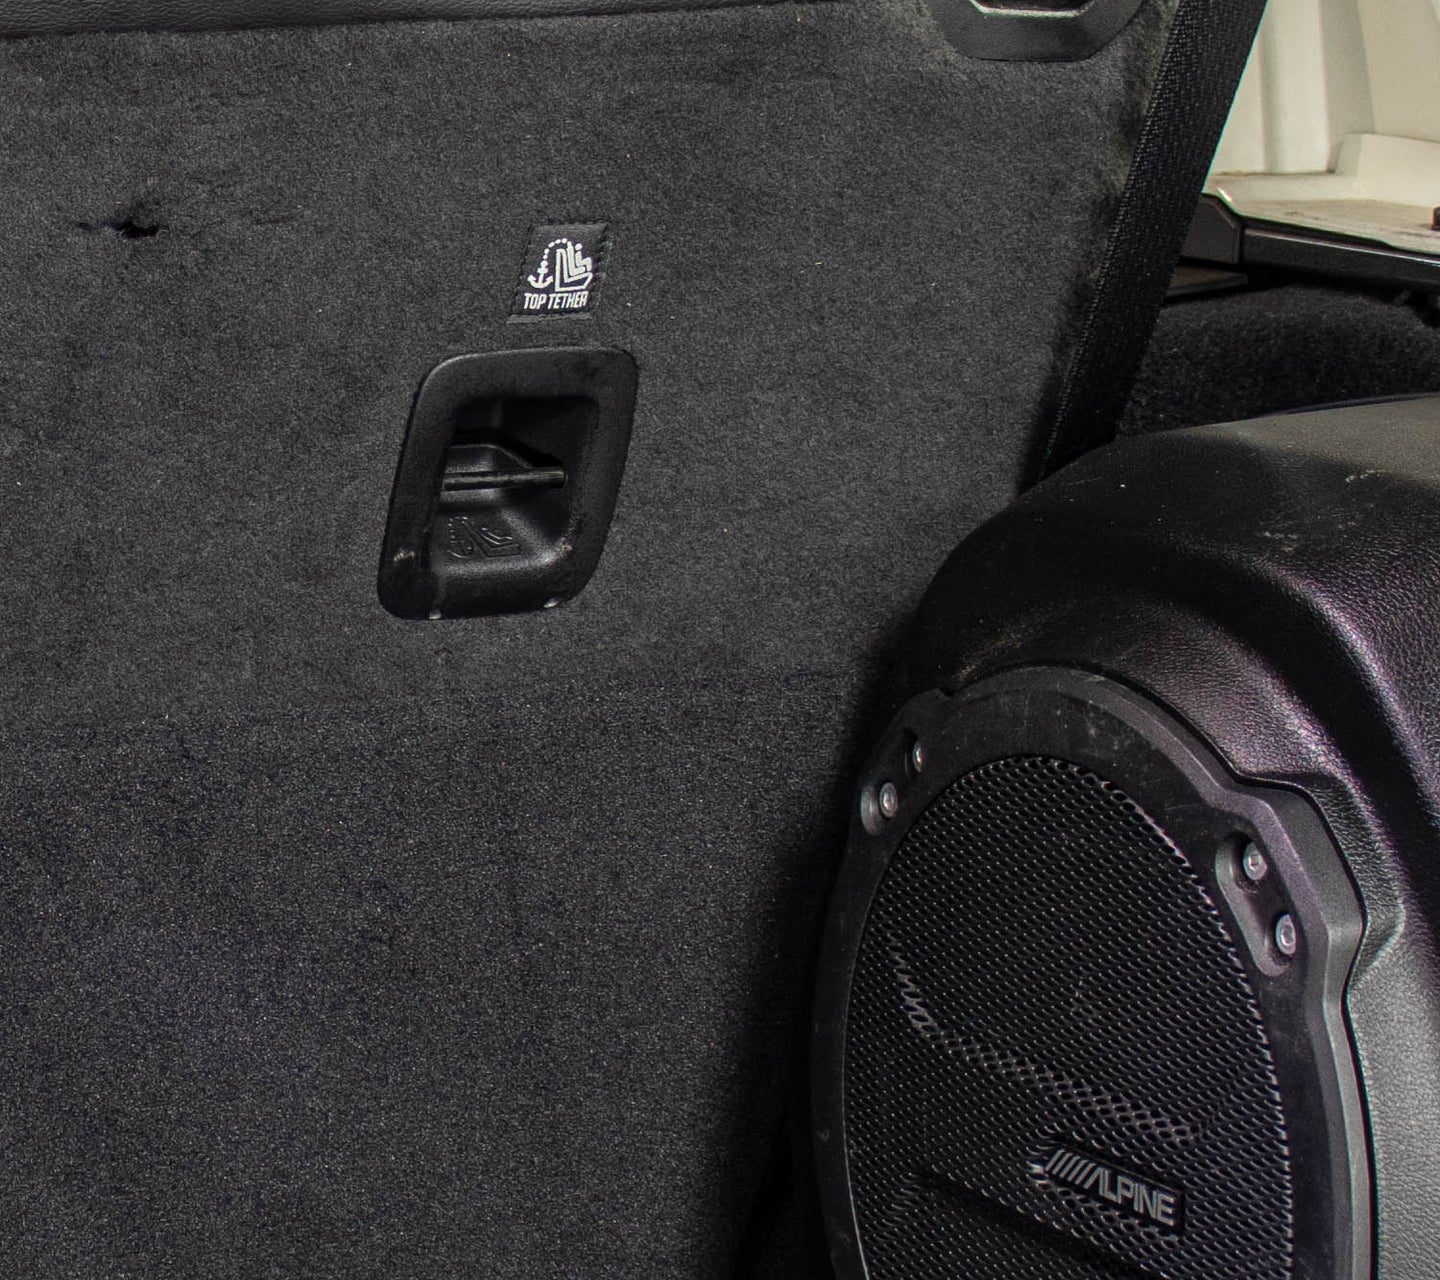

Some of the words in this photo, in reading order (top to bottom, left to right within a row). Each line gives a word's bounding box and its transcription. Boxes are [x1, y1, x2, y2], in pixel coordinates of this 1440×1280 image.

[523, 292, 548, 310] TOP
[547, 291, 589, 310] TETHER
[1044, 1148, 1176, 1227] ALPINE
